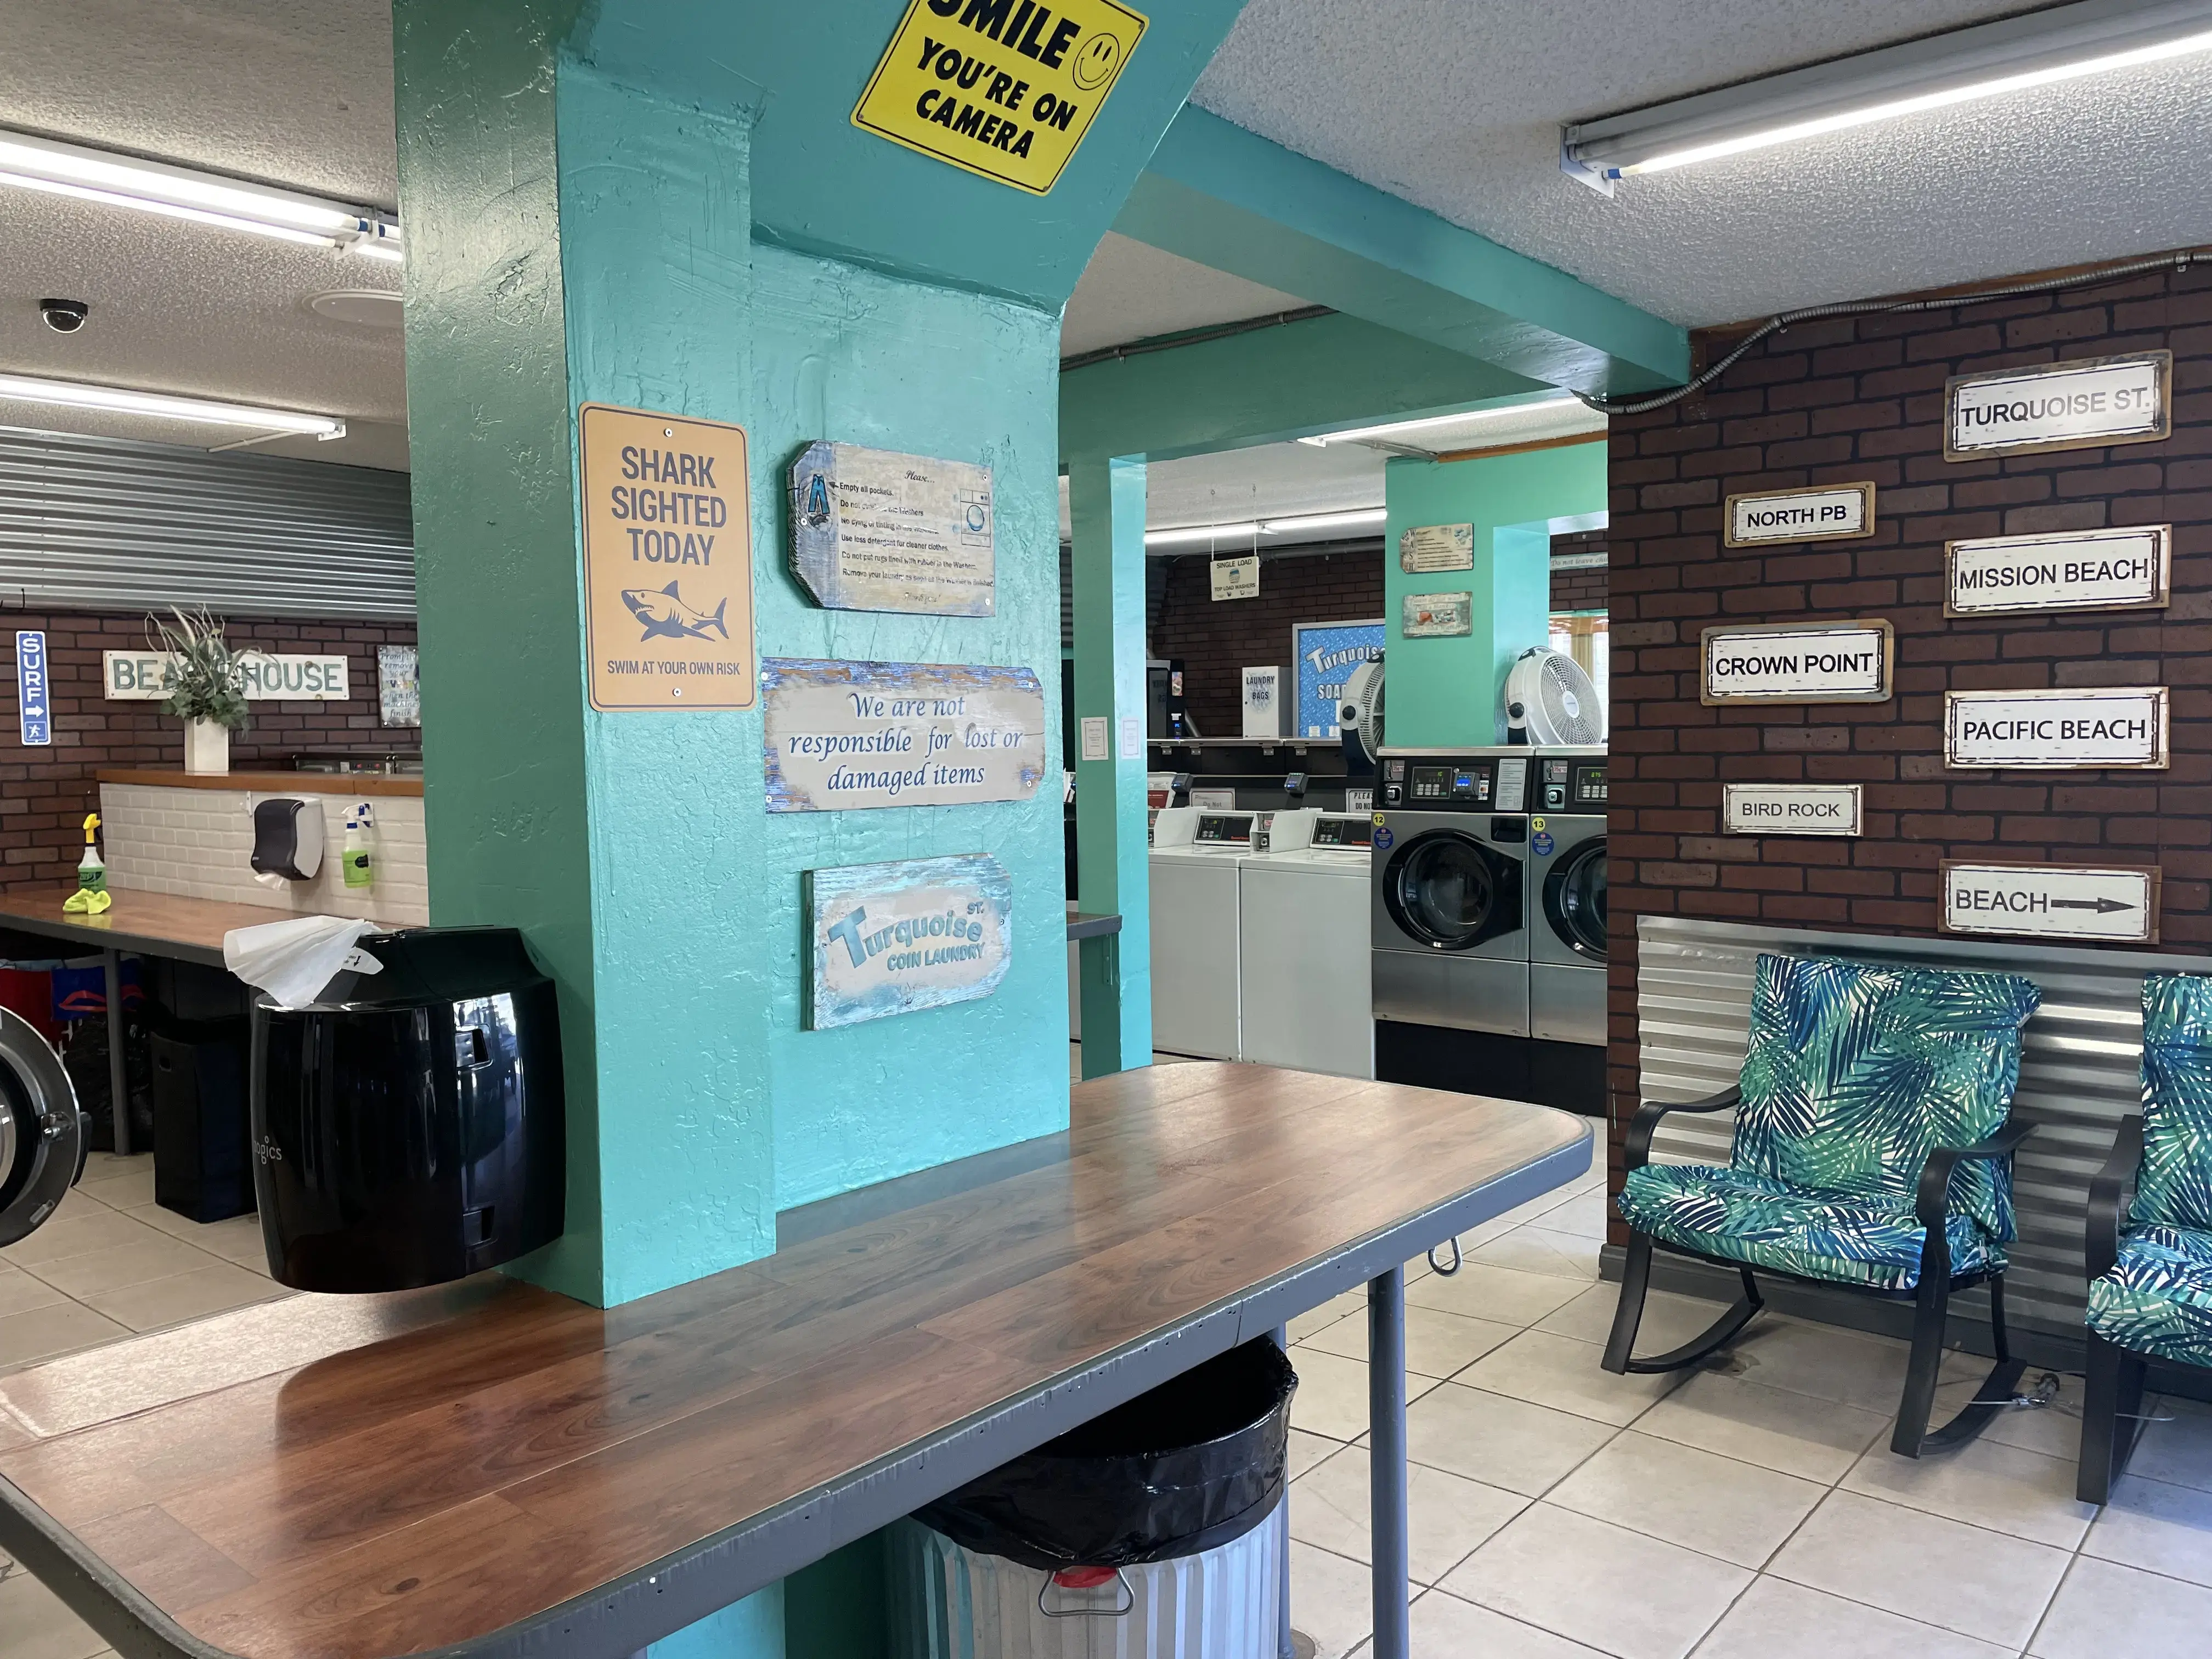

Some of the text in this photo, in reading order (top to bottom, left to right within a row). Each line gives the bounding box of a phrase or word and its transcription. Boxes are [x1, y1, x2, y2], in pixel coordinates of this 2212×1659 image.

[916, 36, 1078, 132] YOU'RE ON
[916, 89, 1035, 159] CAMERA
[1961, 387, 2151, 428] TURQUOISE ST.
[621, 445, 717, 489] SHARK
[840, 482, 860, 493] Empty
[870, 487, 894, 496] pockets.
[611, 485, 727, 528] SIGHTED
[840, 499, 849, 507] Do
[1747, 505, 1847, 528] NORTH PB
[626, 528, 715, 566] TODAY
[842, 534, 853, 542] Use
[854, 535, 866, 544] less
[906, 541, 927, 549] cleaner
[843, 568, 867, 577] Remove
[1216, 561, 1235, 569] SINGLE
[1959, 557, 2148, 590] MISSION BEACH
[22, 637, 42, 703] SURF
[240, 662, 343, 692] HOUSE
[607, 659, 741, 676] SWIM AT YOUR OWN RISK
[1716, 652, 1874, 677] CROWN POINT
[1246, 675, 1276, 685] LAUNDRY
[849, 692, 966, 718] We are not
[1252, 691, 1269, 701] BAGS
[1963, 718, 2147, 742] PACIFIC BEACH
[788, 725, 1023, 762] responsible for lost or
[827, 762, 985, 795] damaged items
[1742, 803, 1841, 818] BIRD ROCK
[1955, 889, 2048, 913] BEACH
[827, 901, 985, 969] Turquoise ST.
[887, 941, 985, 972] COIN LAUNDRY
